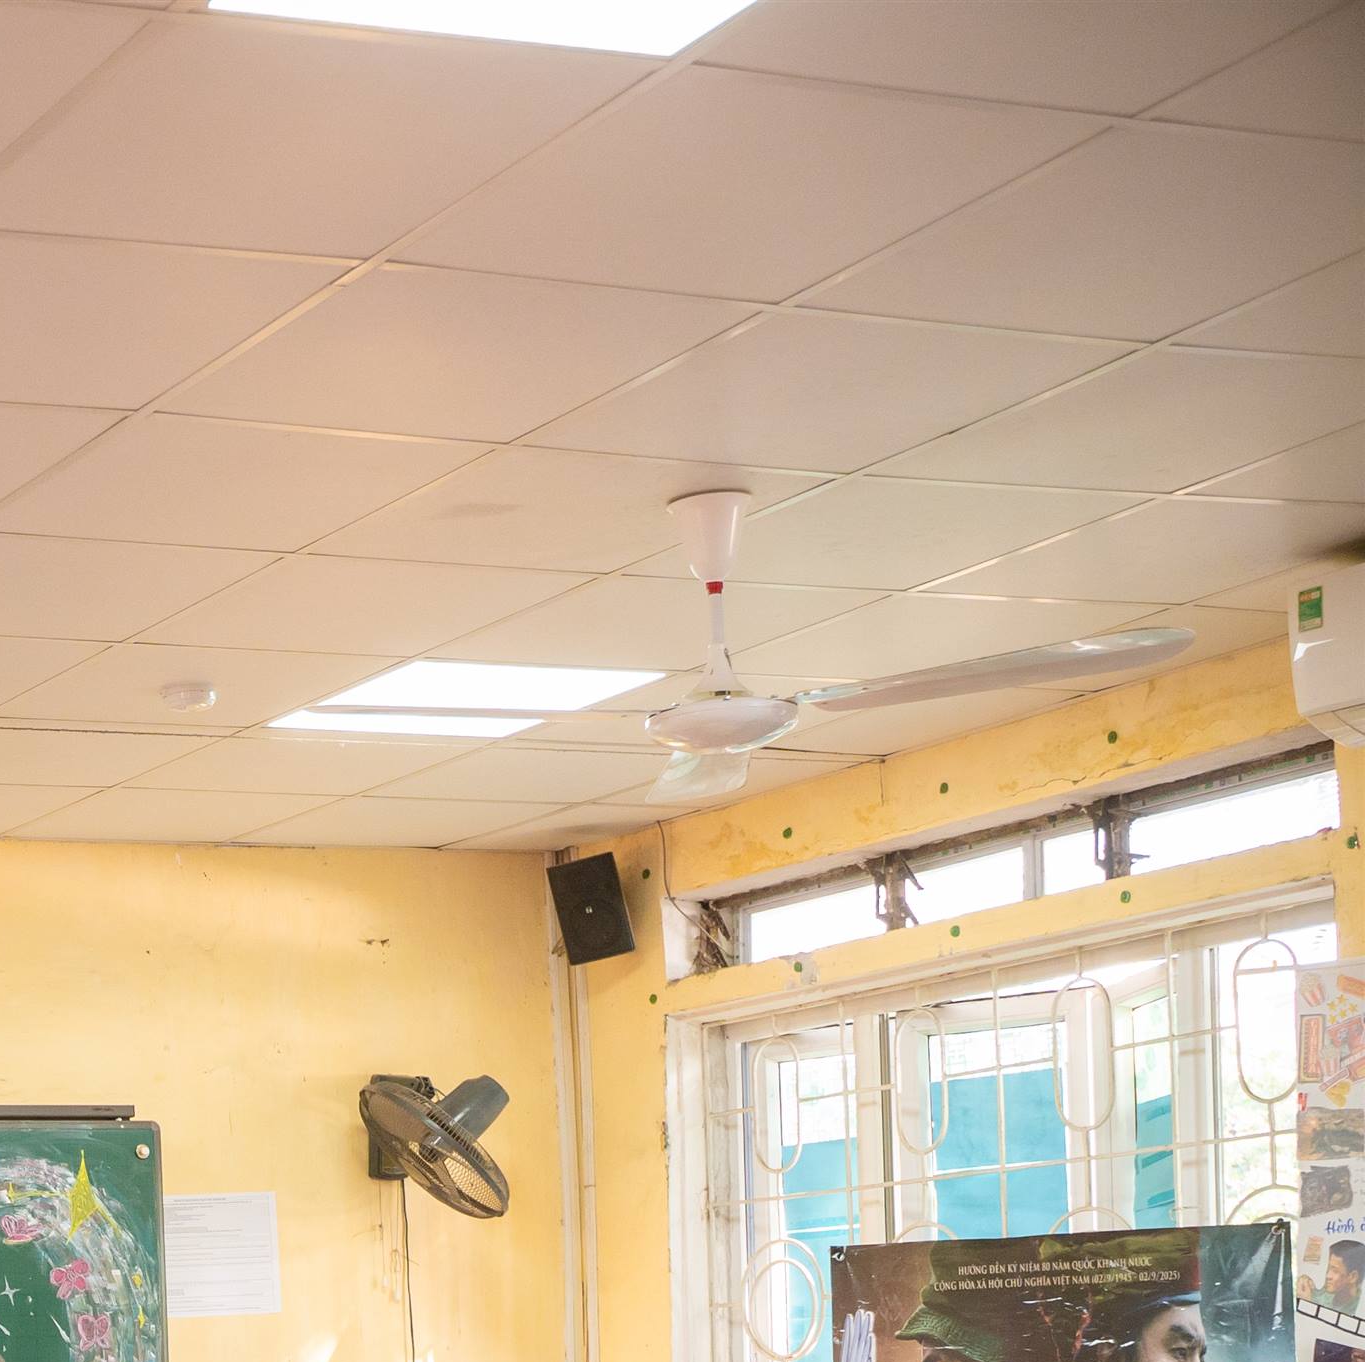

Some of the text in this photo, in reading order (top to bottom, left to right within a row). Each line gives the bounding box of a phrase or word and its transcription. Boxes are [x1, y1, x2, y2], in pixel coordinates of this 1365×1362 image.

[957, 1264, 988, 1276] HƯỚNG
[1041, 1262, 1051, 1271] 80
[1071, 1257, 1096, 1271] QUỐC
[933, 1280, 958, 1292] CỘNG
[988, 1277, 1003, 1291] HỘI
[1024, 1275, 1051, 1287] NGHĨA
[1071, 1275, 1090, 1285] NAM
